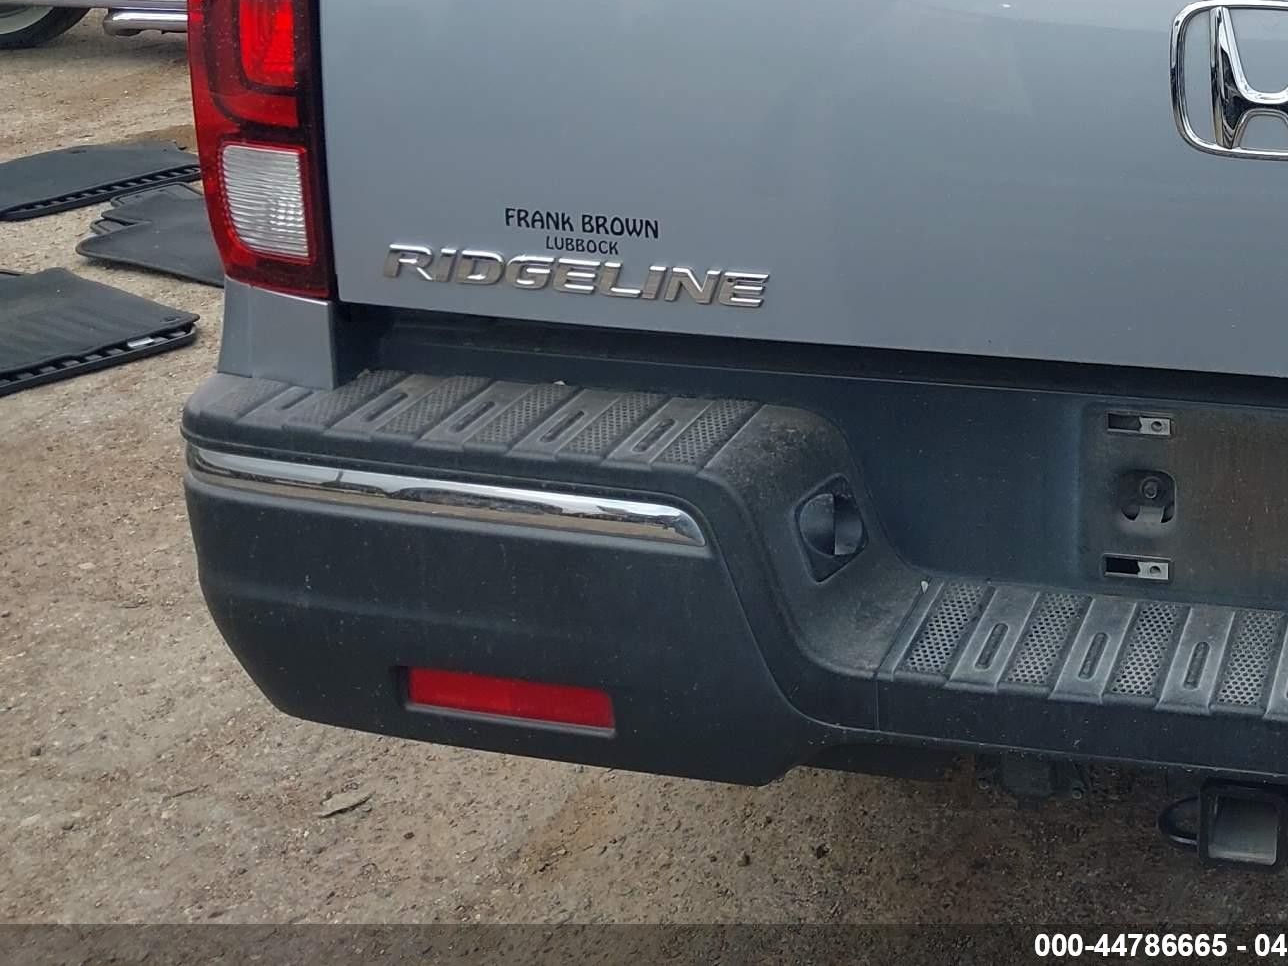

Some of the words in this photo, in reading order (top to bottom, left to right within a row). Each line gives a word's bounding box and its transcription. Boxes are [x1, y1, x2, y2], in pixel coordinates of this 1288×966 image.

[504, 207, 575, 233] FRANK
[581, 214, 660, 239] BROWN
[545, 235, 619, 256] LUBBOCK
[383, 242, 770, 308] RIDGELINE
